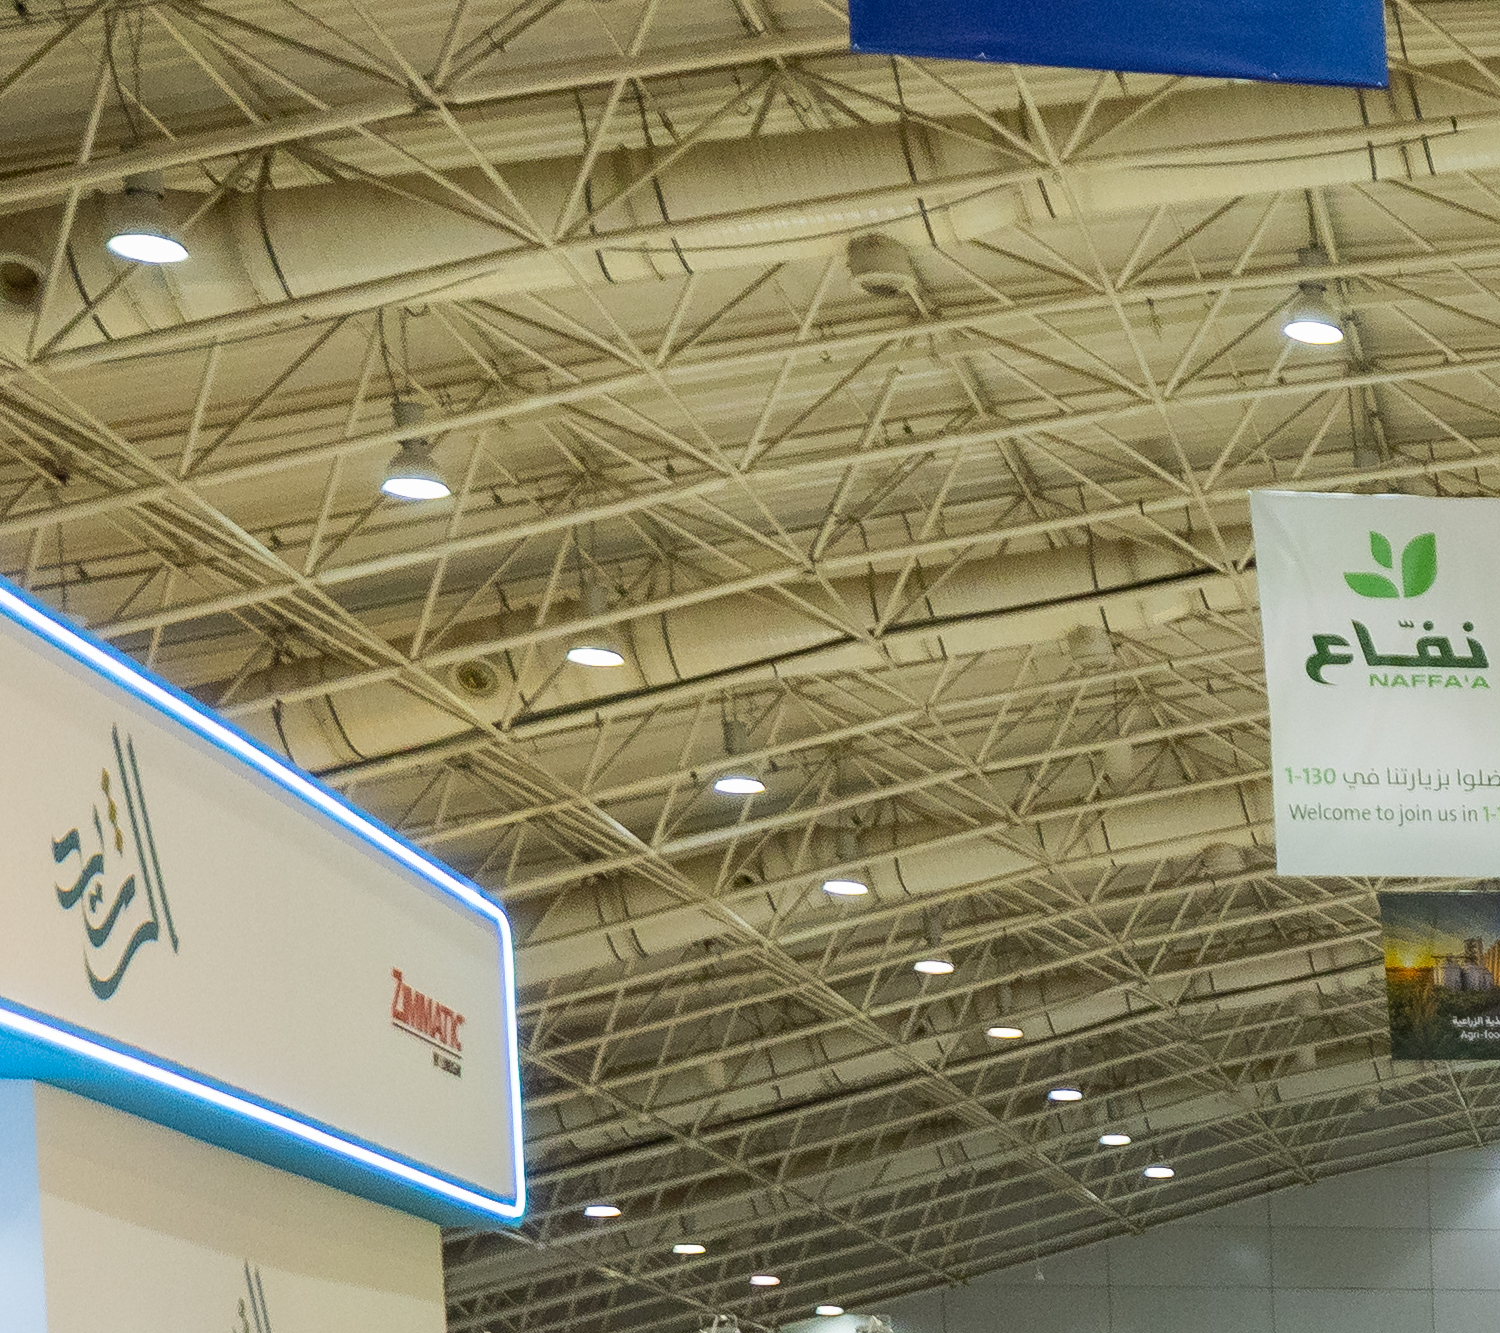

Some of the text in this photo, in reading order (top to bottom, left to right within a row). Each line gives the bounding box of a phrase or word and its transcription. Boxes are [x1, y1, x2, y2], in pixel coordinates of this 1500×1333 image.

[1369, 673, 1490, 689] NAFFA'A
[1285, 767, 1336, 784] 1-130
[1343, 767, 1380, 789] في
[1386, 767, 1450, 791] بزيارتنا
[1289, 803, 1371, 821] Welcome
[1376, 806, 1394, 821] to
[1399, 803, 1432, 826] join
[1438, 809, 1457, 822] us
[1462, 805, 1478, 822] in
